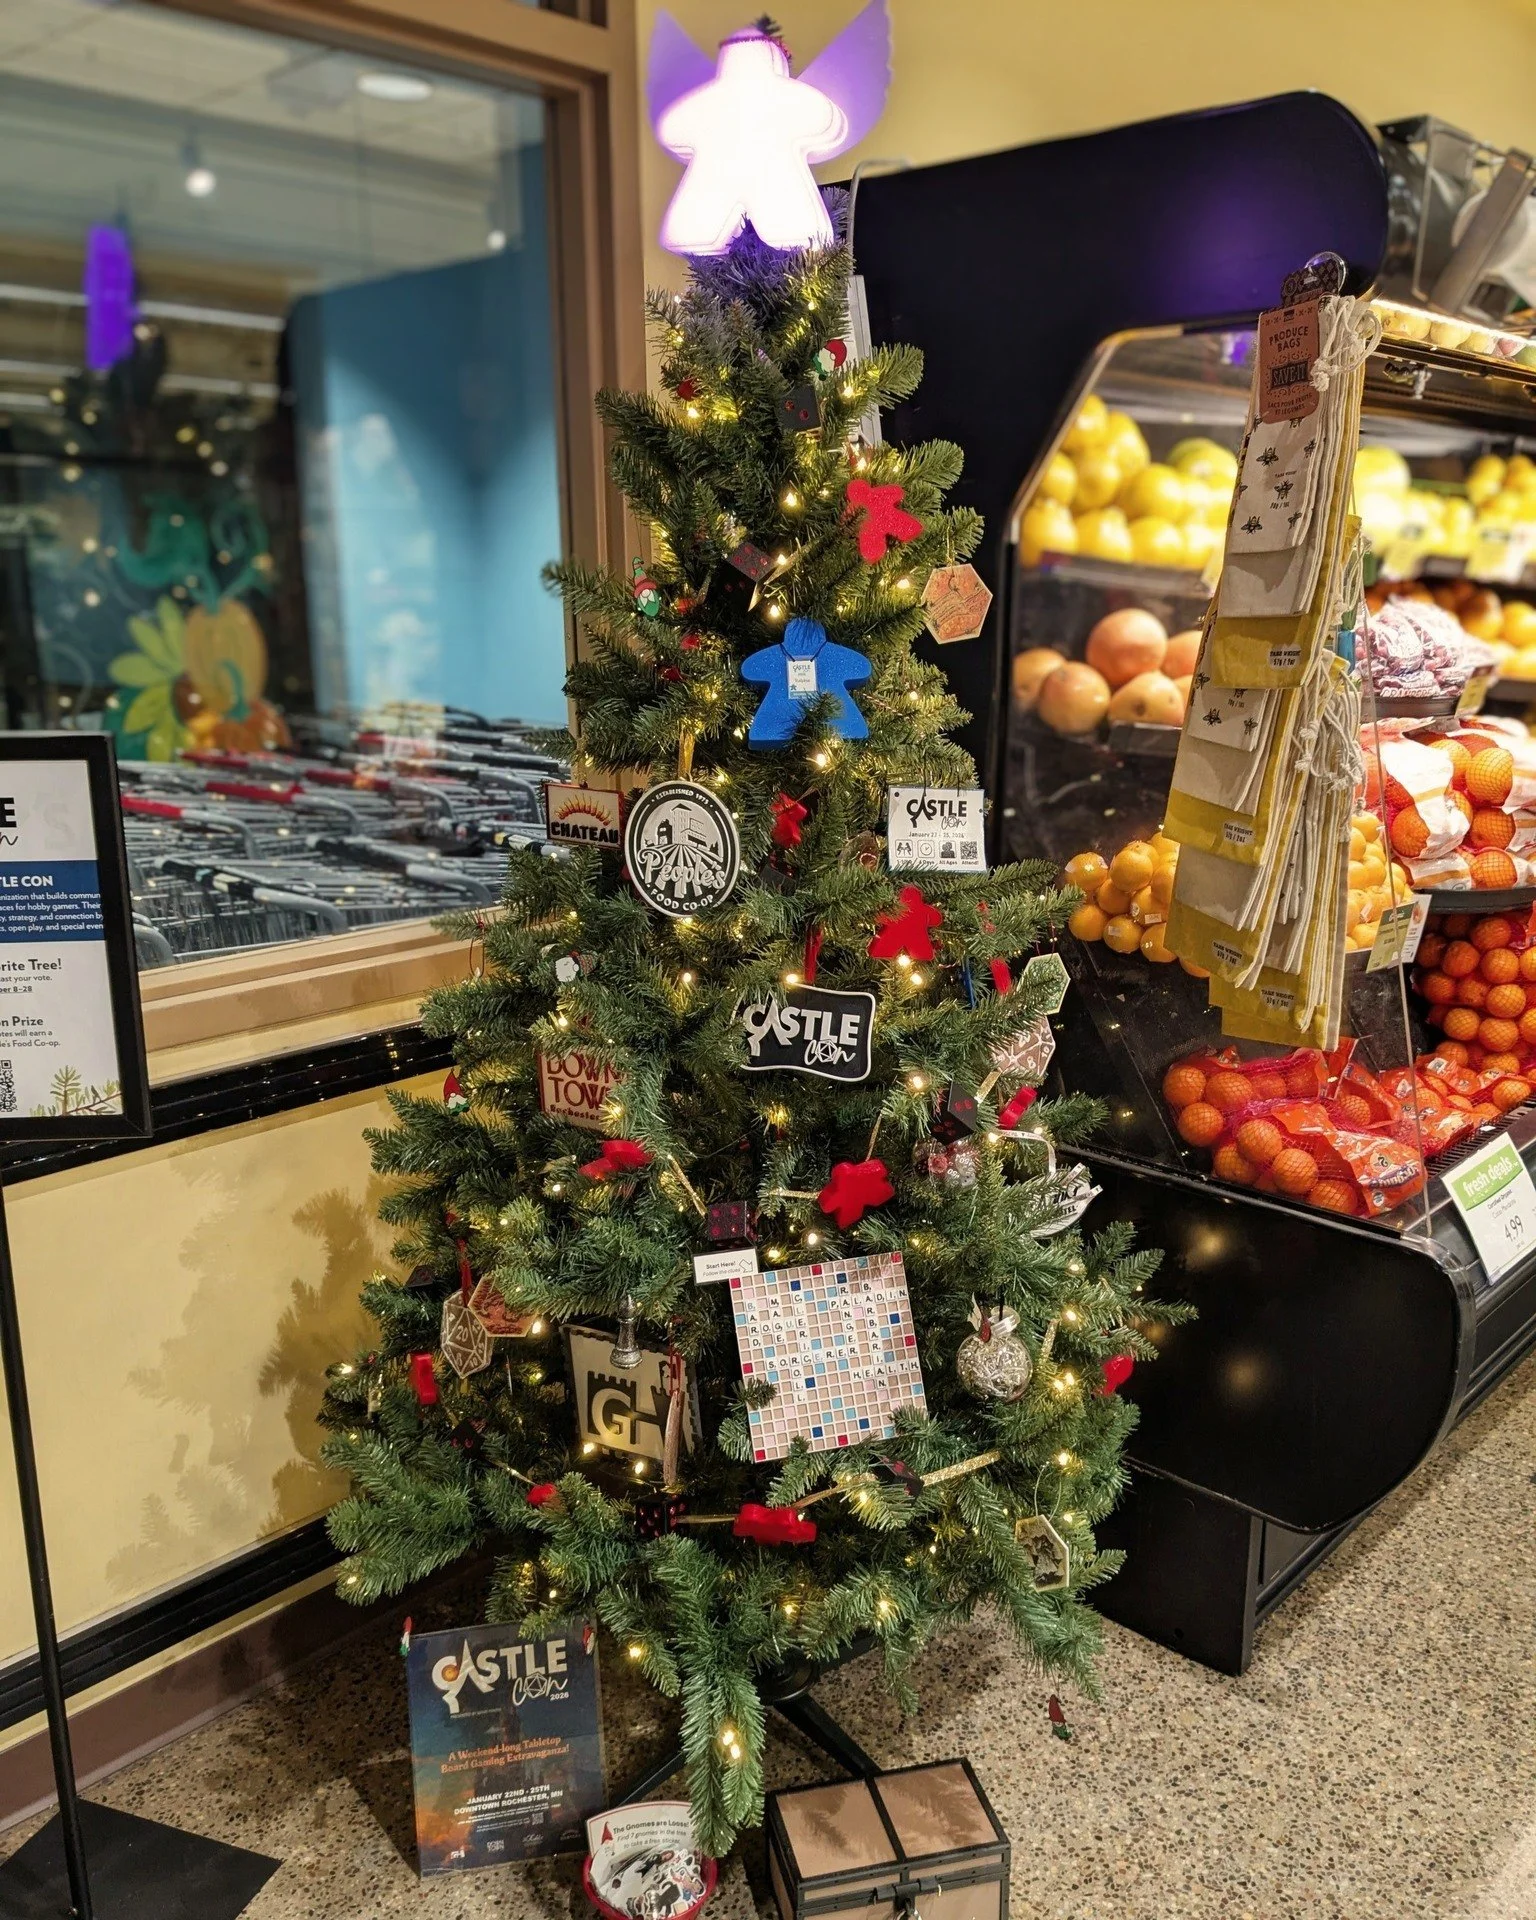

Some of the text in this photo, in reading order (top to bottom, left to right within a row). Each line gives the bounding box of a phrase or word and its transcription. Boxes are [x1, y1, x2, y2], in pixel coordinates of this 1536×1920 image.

[1269, 325, 1309, 346] PRODUCE
[1277, 337, 1301, 353] BAGS
[655, 788, 694, 800] ESTABLISHED
[906, 796, 967, 828] CASTLE
[551, 821, 620, 844] CHATEAU
[1233, 826, 1254, 836] WEIGHT
[637, 849, 726, 892] People's
[0, 875, 53, 887] LE CON
[31, 892, 45, 900] that
[46, 892, 68, 900] builds
[650, 887, 714, 911] FOOD CO-OP
[15, 903, 26, 911] for
[27, 903, 51, 912] hobby
[52, 904, 80, 912] gamers.
[81, 901, 101, 910] Their
[8, 914, 38, 922] strategy,
[40, 912, 53, 921] and
[55, 912, 94, 920] connection
[28, 923, 44, 933] play,
[46, 923, 60, 931] and
[61, 922, 85, 931] special
[1224, 946, 1242, 960] WEIGHT
[0, 958, 62, 972] rite Tree!
[13, 976, 31, 984] your
[1275, 991, 1295, 1000] WEIGHT
[0, 1015, 44, 1027] n Prize
[742, 991, 861, 1056] CASTLE
[34, 1039, 61, 1048] Co-op.
[1462, 1171, 1489, 1198] fresh
[1488, 1157, 1513, 1181] deals
[1504, 1215, 1524, 1242] 4.99
[720, 1260, 736, 1268] Here!
[830, 1289, 908, 1308] PALADIN
[747, 1302, 761, 1346] BARD
[750, 1319, 807, 1335] ROGUE
[770, 1299, 785, 1342] MAGE
[456, 1325, 469, 1343] 20
[768, 1347, 858, 1369] SORCERER
[853, 1361, 919, 1379] HEALTH
[431, 1638, 568, 1714] CASTLE
[549, 1691, 570, 1701] 2026
[448, 1737, 562, 1762] A Weekend-long Tabletop
[441, 1744, 570, 1774] Board Gaming Extravaganza!
[454, 1790, 563, 1815] DOWNTOWN ROCHESTER, MN
[467, 1792, 503, 1805] JANUARY
[504, 1789, 525, 1798] 22ND
[530, 1784, 550, 1794] 25TH
[613, 1826, 625, 1835] The
[625, 1821, 655, 1831] Gnomes
[617, 1834, 630, 1842] Find
[635, 1830, 658, 1839] gnomes
